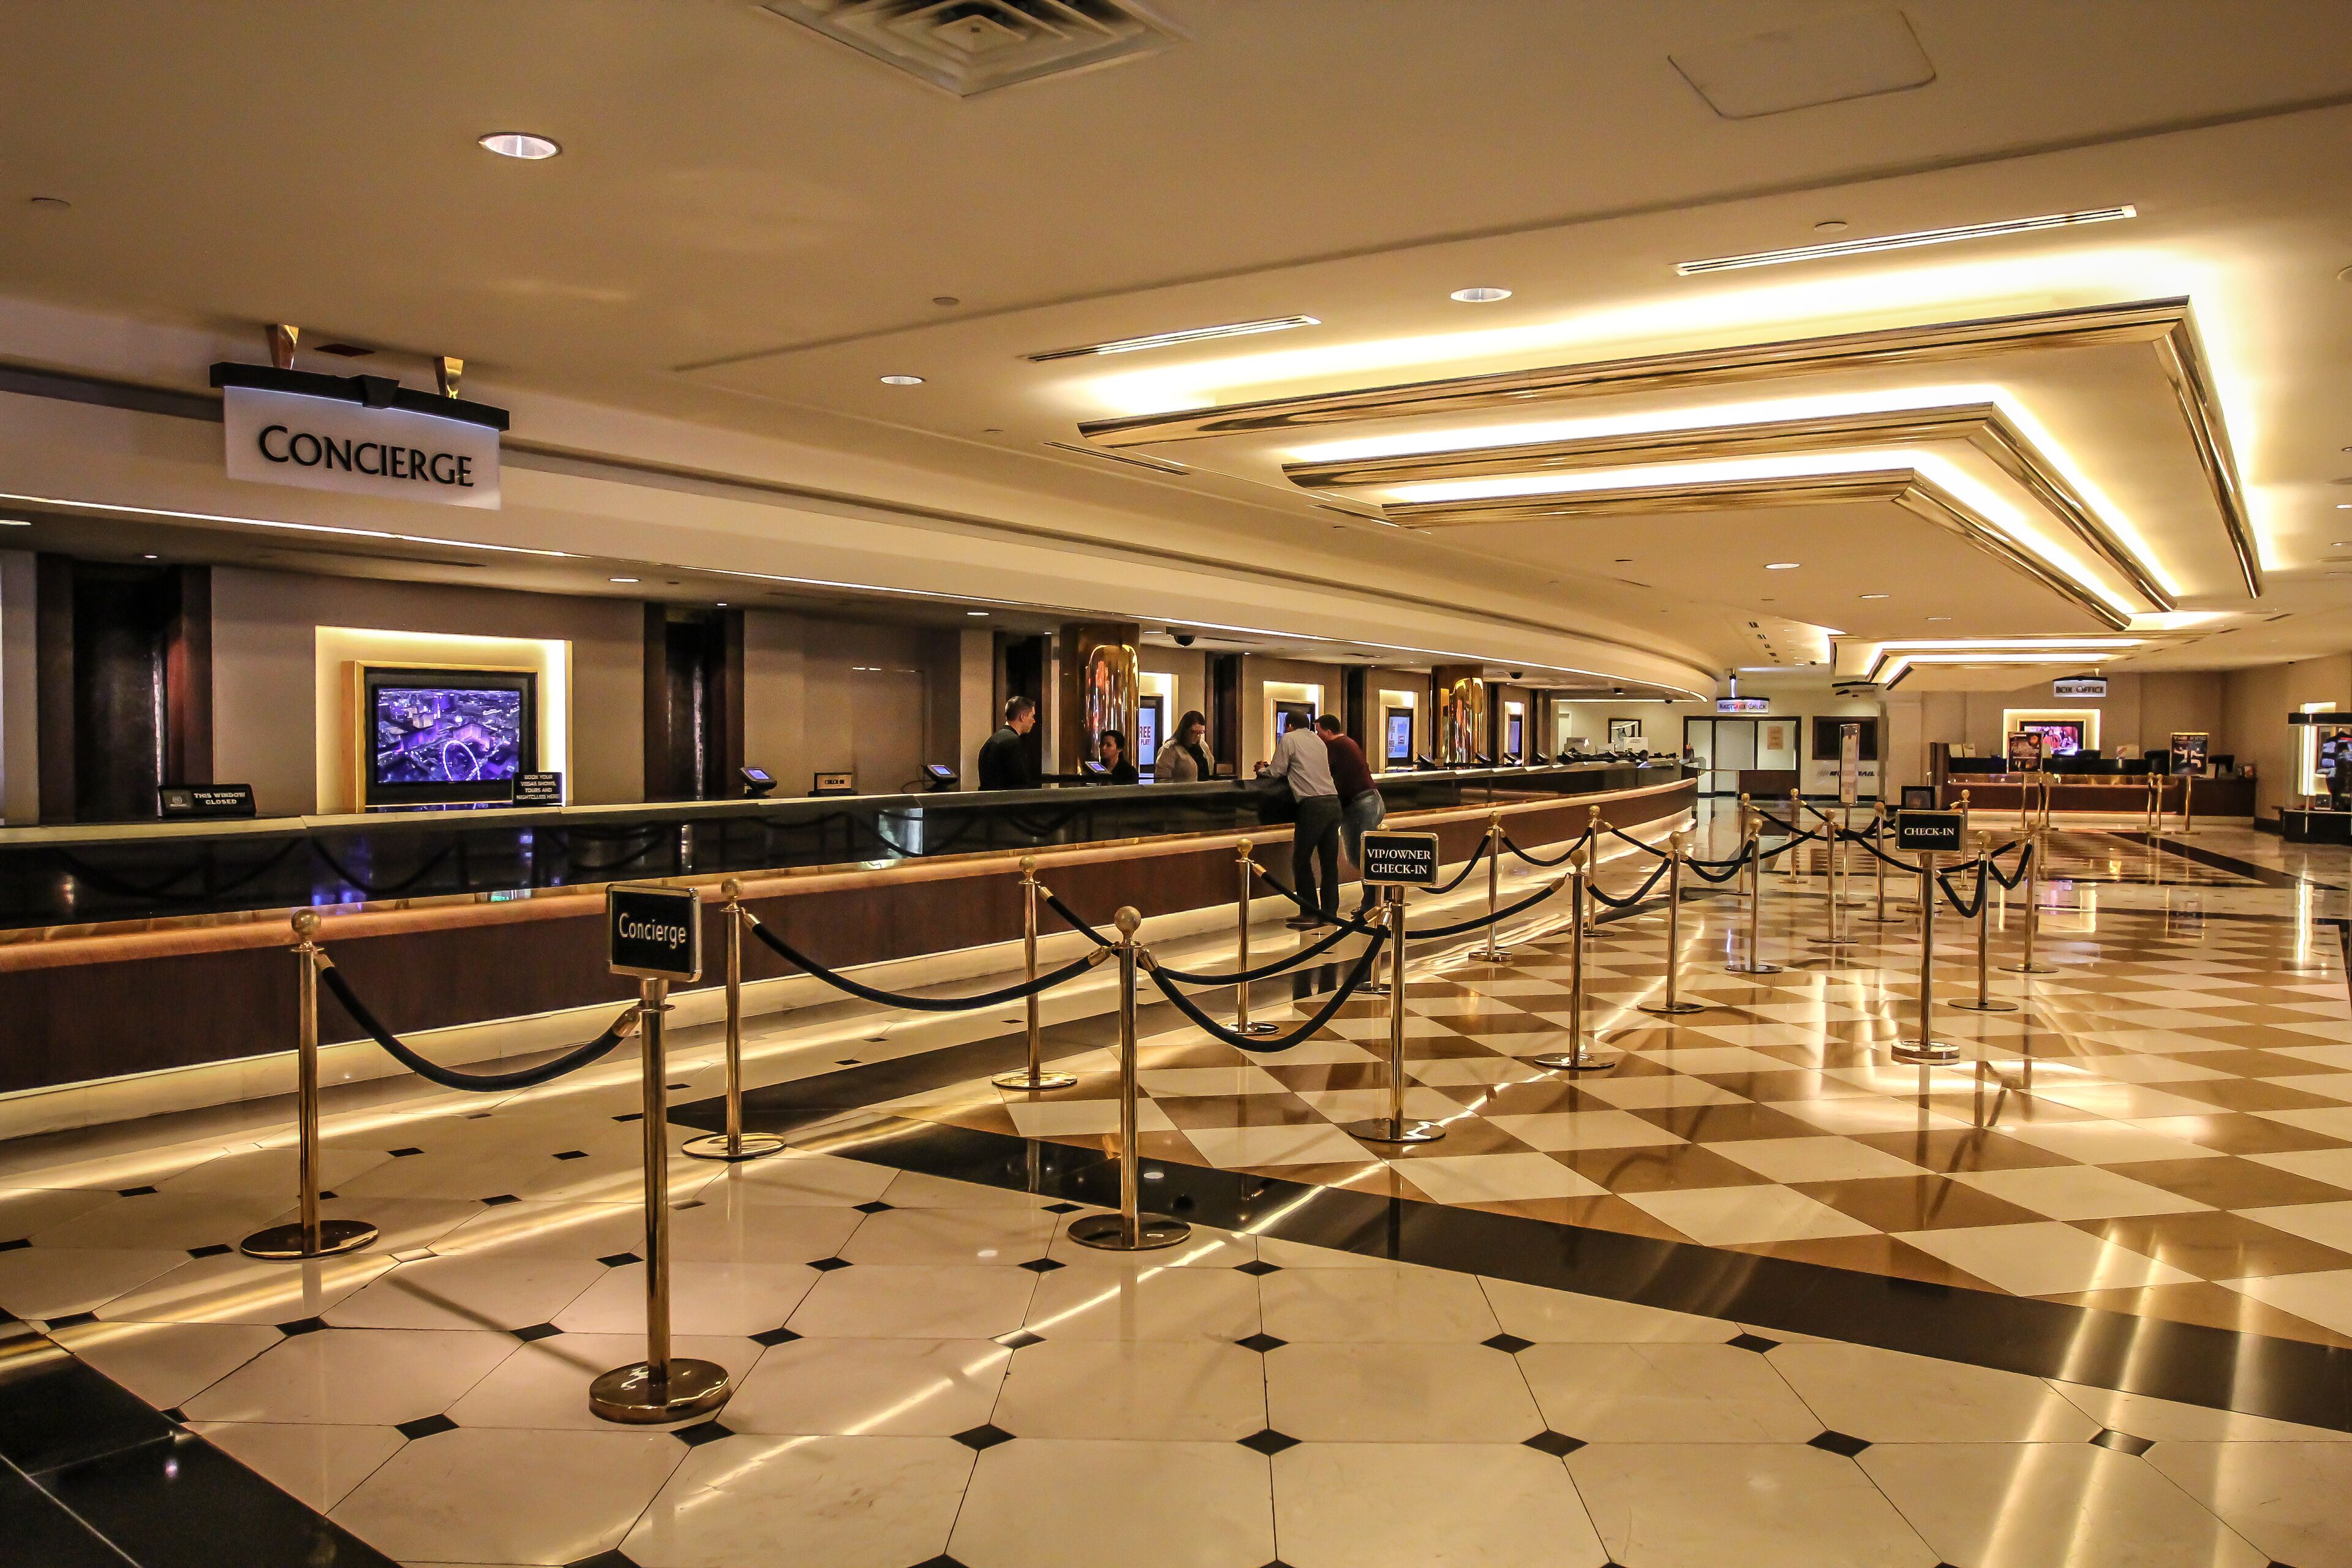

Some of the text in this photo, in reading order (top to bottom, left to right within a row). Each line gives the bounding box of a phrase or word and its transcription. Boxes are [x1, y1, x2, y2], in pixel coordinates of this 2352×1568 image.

[258, 425, 475, 488] CONCIERGE
[1140, 726, 1151, 738] REE
[1366, 849, 1431, 859] VIP/OWNER
[1371, 864, 1428, 874] CHECK-IN
[619, 913, 687, 949] Concierge
